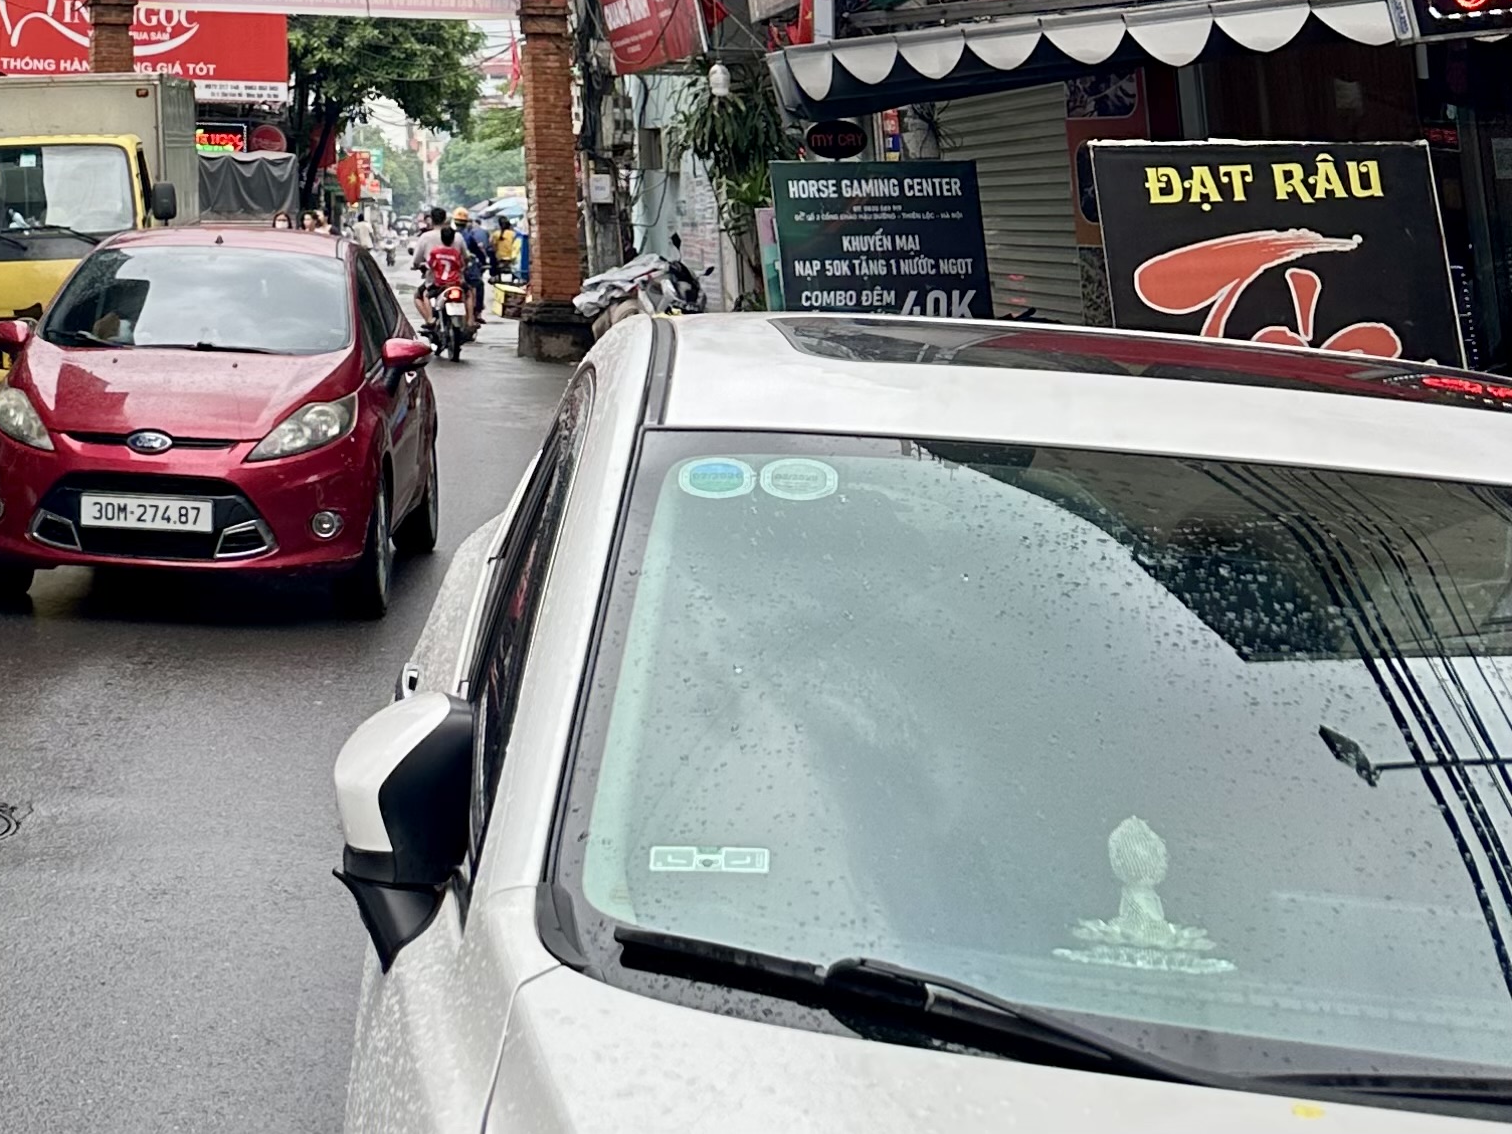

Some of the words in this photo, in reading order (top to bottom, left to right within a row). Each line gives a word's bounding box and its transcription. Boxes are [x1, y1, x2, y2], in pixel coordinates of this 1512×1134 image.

[133, 7, 198, 33] GỌC
[0, 56, 56, 71] THỐNG
[155, 60, 184, 75] GIÁ
[186, 60, 217, 76] TỐT
[788, 179, 838, 198] HORSE
[841, 178, 899, 198] GAMING
[903, 177, 962, 197] CENTER
[1145, 164, 1253, 212] ĐẠT
[1270, 153, 1384, 203] RÂU
[842, 228, 892, 252] KHUYẾN
[896, 235, 920, 255] MẠI
[794, 260, 821, 281] NẠP
[825, 260, 851, 276] 50K
[852, 256, 887, 280] TẶNG
[889, 260, 896, 275] 1
[900, 254, 936, 276] NƯỚC
[940, 258, 973, 279] NGỌT
[801, 290, 857, 307] COMBO
[861, 286, 896, 307] ĐÊM
[92, 501, 201, 526] 30M-274.87
